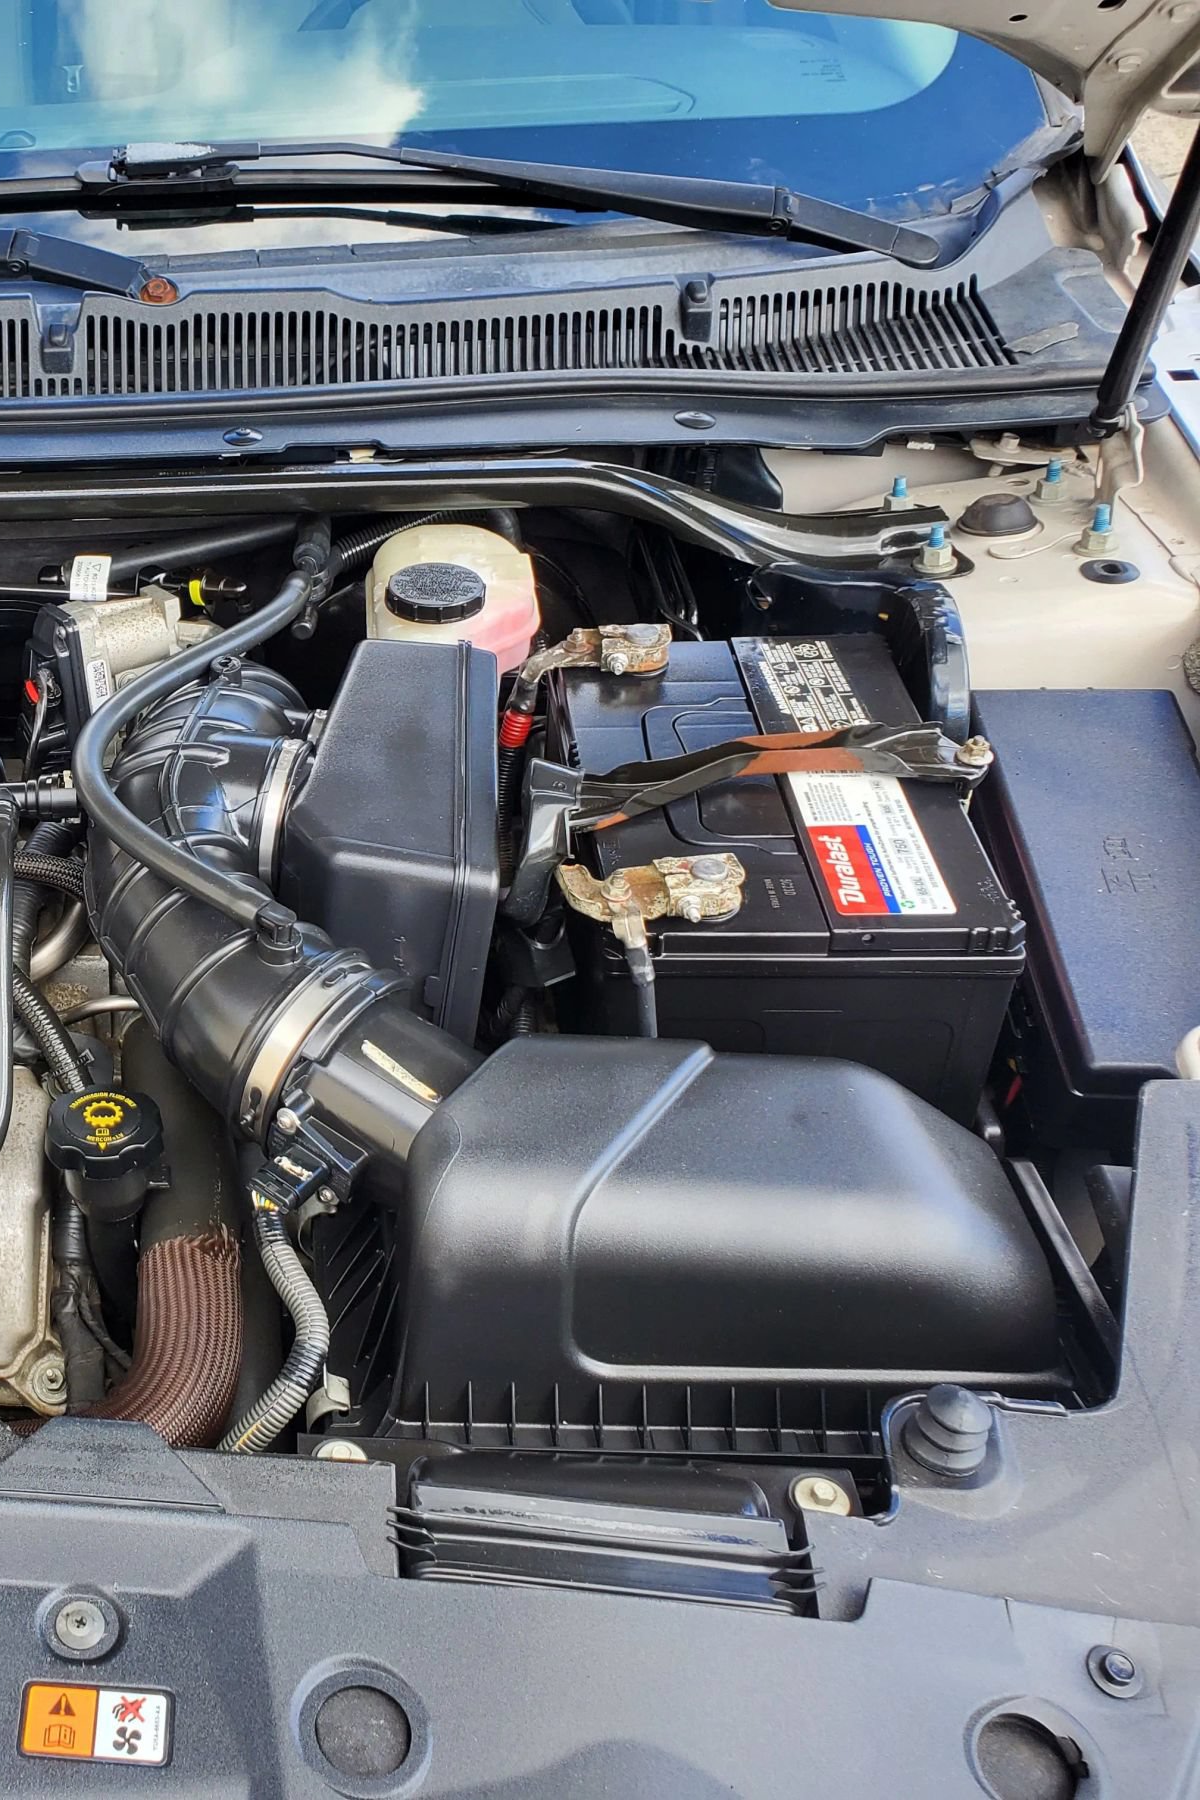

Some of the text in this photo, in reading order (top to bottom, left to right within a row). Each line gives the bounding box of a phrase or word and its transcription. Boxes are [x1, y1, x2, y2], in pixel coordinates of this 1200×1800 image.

[816, 835, 867, 905] Duralast
[863, 842, 892, 896] PROVEN TOUGH
[891, 839, 909, 853] 750
